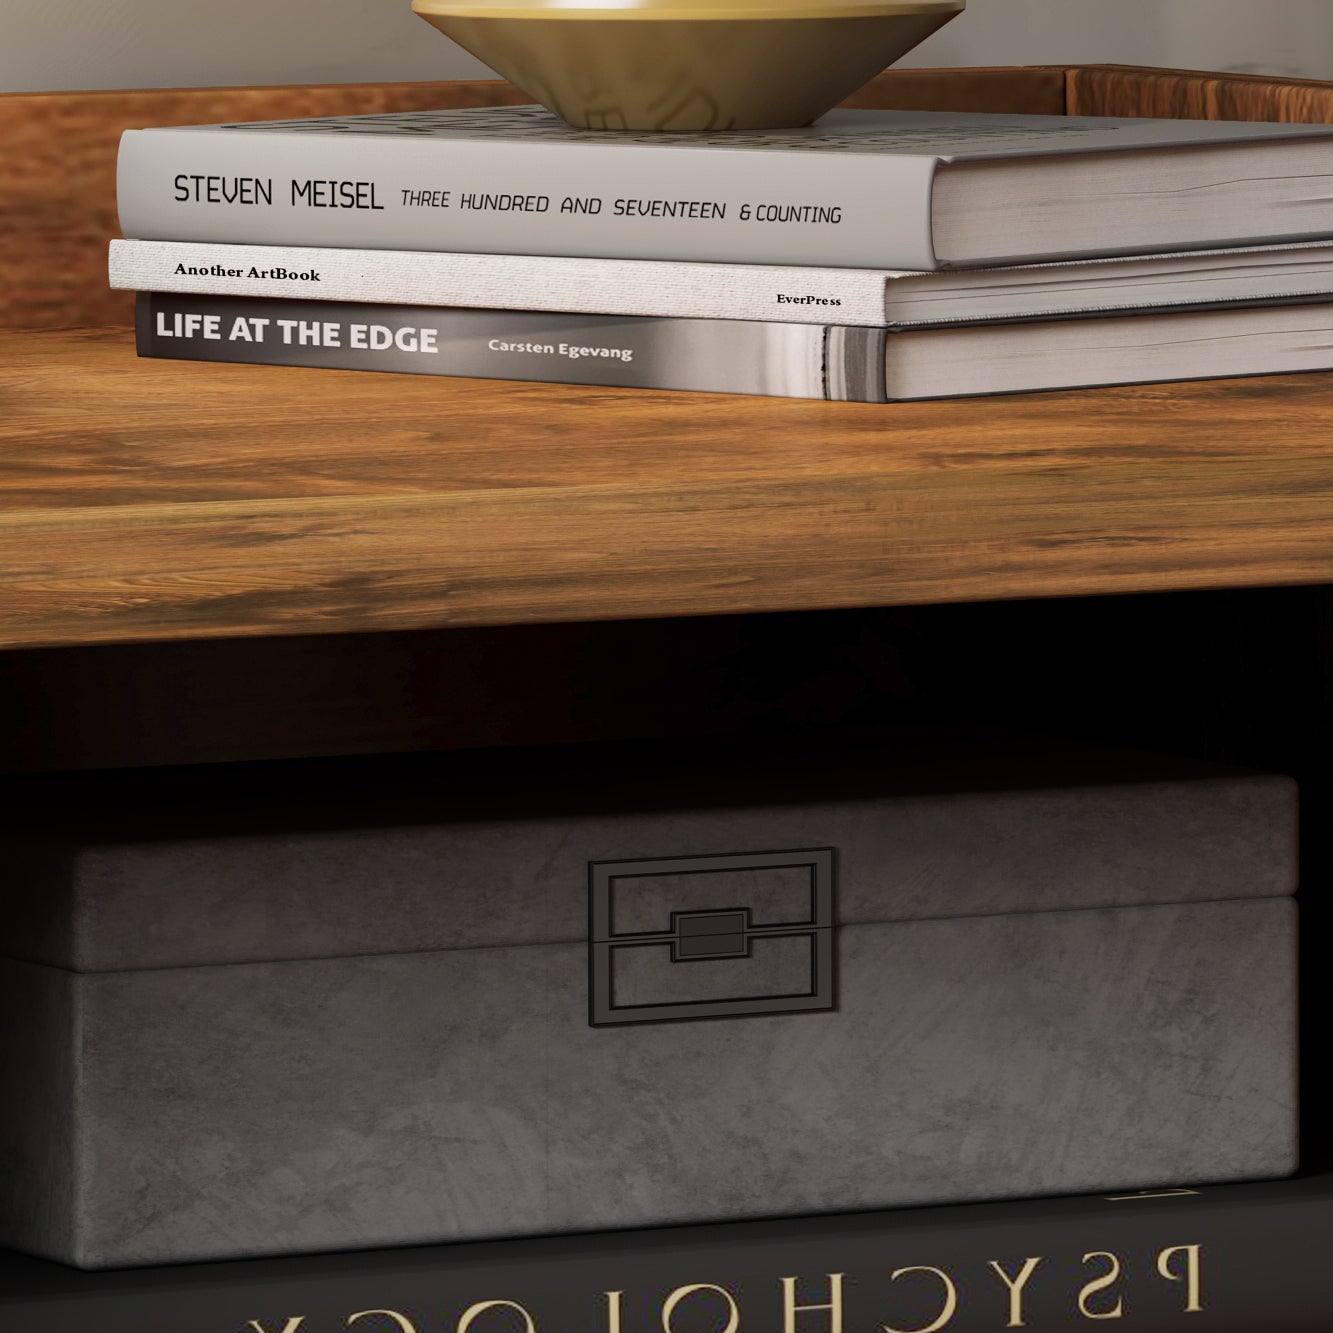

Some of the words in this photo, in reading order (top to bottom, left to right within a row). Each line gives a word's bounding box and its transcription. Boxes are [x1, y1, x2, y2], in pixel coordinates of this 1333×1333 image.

[174, 174, 272, 206] STEVEN
[291, 179, 385, 210] MEISEL
[401, 189, 451, 208] THREE
[460, 193, 550, 213] HUNDRED
[560, 197, 602, 215] AND
[613, 198, 727, 219] SEVENTEEN
[739, 203, 752, 221] &
[756, 204, 842, 224] COUNTING
[174, 263, 244, 278] Another
[246, 266, 321, 282] ArtBook
[777, 294, 841, 307] EverPress
[157, 312, 221, 340] LIFE
[228, 317, 270, 343] AT
[276, 319, 341, 348] THE
[349, 324, 439, 354] EDGE
[488, 339, 554, 355] Carsten
[558, 343, 633, 362] Egevang
